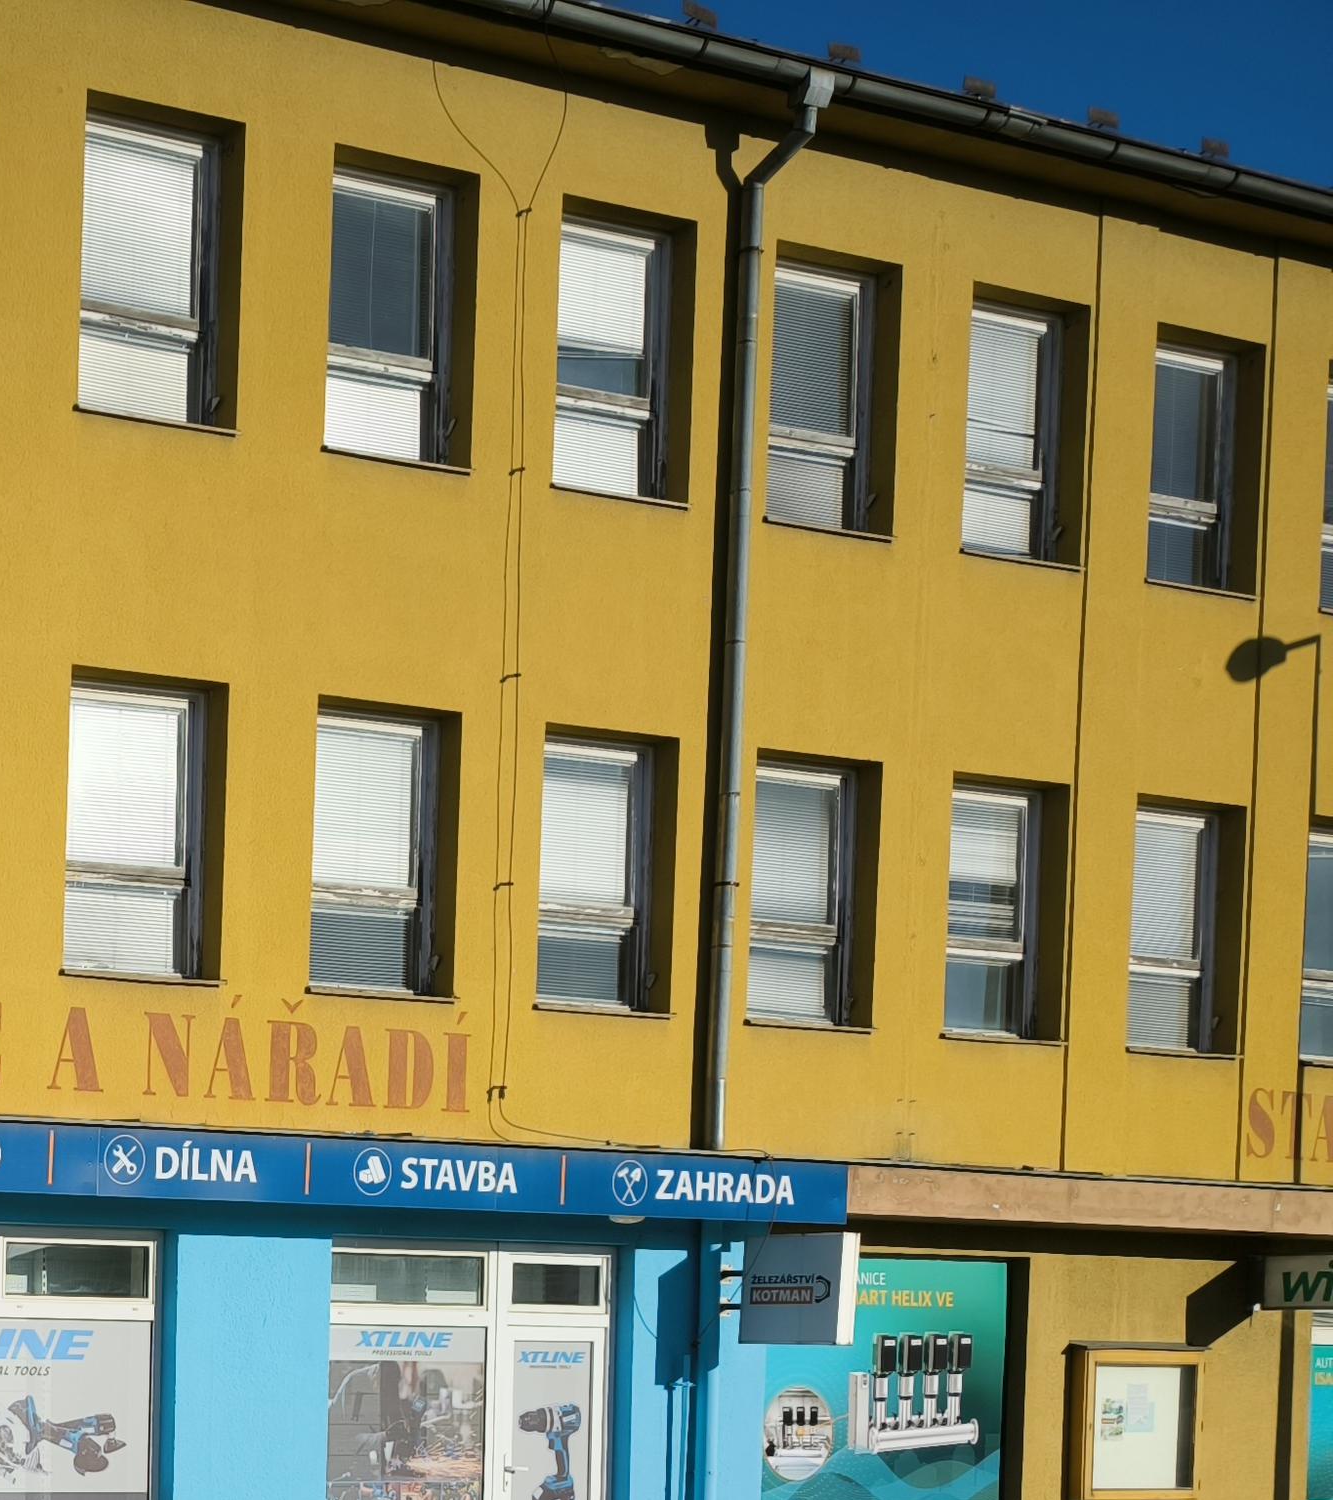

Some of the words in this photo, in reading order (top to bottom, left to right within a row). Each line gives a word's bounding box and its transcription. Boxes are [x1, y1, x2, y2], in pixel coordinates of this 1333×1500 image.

[47, 1006, 104, 1093] A
[142, 994, 472, 1113] NÁŘADÍ
[154, 1140, 258, 1184] DÍLNA
[400, 1157, 518, 1195] STAVBA
[655, 1169, 795, 1207] ZAHRADA
[751, 1273, 814, 1285] ŽELEZÁŘSTVÍ
[753, 1289, 811, 1302] KOTMAN
[891, 1290, 932, 1307] HELIX
[936, 1291, 954, 1307] VE
[356, 1331, 453, 1348] XTLINE
[517, 1351, 586, 1364] XTLINE
[14, 1365, 51, 1376] TOOLS
